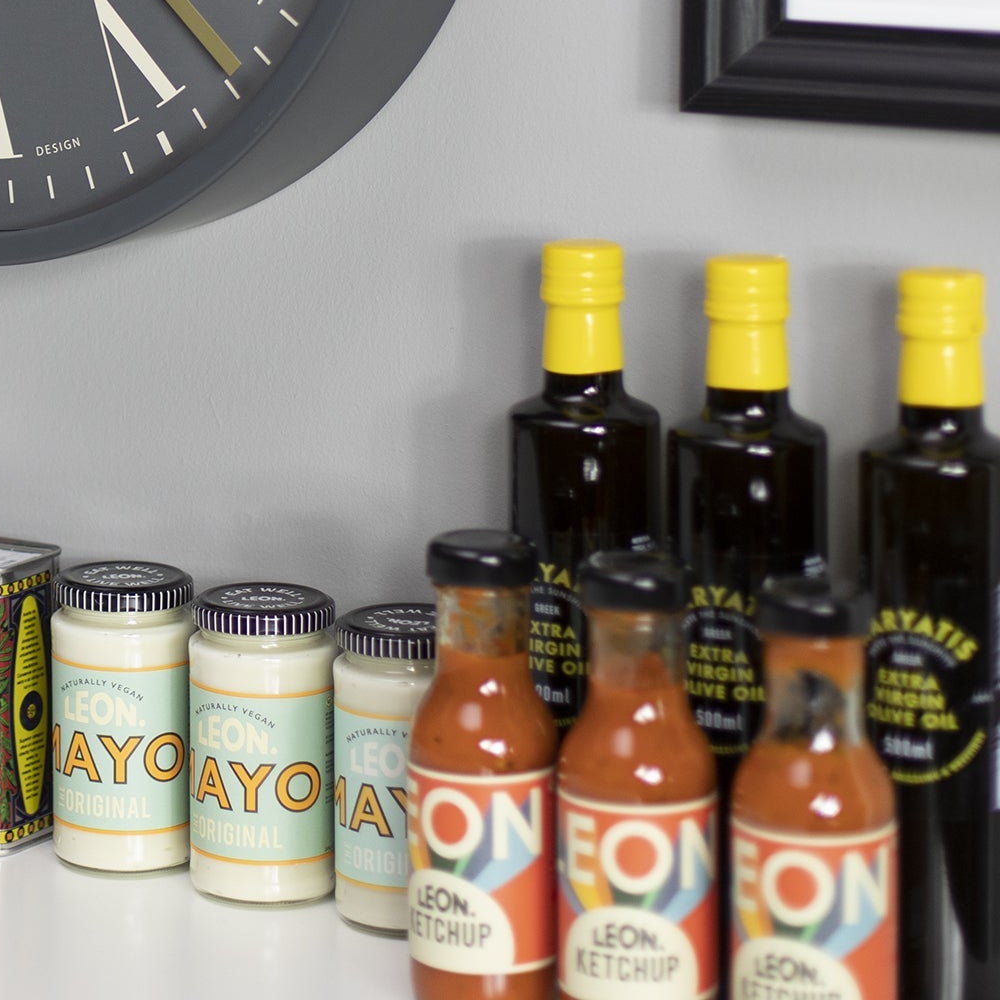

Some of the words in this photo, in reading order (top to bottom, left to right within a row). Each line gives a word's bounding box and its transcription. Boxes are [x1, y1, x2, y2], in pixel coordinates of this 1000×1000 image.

[35, 137, 81, 157] DESIGN
[115, 565, 159, 575] WELL
[260, 587, 302, 597] WELL
[530, 620, 577, 640] XTRA
[869, 609, 979, 661] ARYATIS
[529, 638, 581, 658] IRGIN
[689, 642, 749, 664] EXTRA
[529, 656, 555, 674] IVE
[686, 660, 754, 683] VIRGIN
[61, 678, 107, 692] NATURALLY
[111, 682, 144, 702] VEGAN
[877, 667, 940, 691] EXTRA
[732, 685, 766, 701] OIL
[64, 690, 146, 728] LEON.
[195, 702, 239, 715] NATURALLY
[242, 708, 276, 728] VEGAN
[696, 709, 743, 731] 500ml
[920, 712, 959, 731] OIL
[198, 715, 278, 756] LEON.
[346, 728, 397, 743] NATURALLY
[350, 741, 407, 778] LEO
[66, 788, 151, 819] ORIGINAL
[199, 815, 283, 849] ORIGINAL
[408, 778, 543, 860] EON
[353, 844, 408, 875] ORIGI
[560, 811, 715, 895] EON
[733, 838, 889, 927] EON
[417, 883, 476, 917] LEON.
[410, 908, 492, 948] KETCHUP
[593, 922, 665, 951] LEON.
[576, 947, 680, 982] KETCHUP
